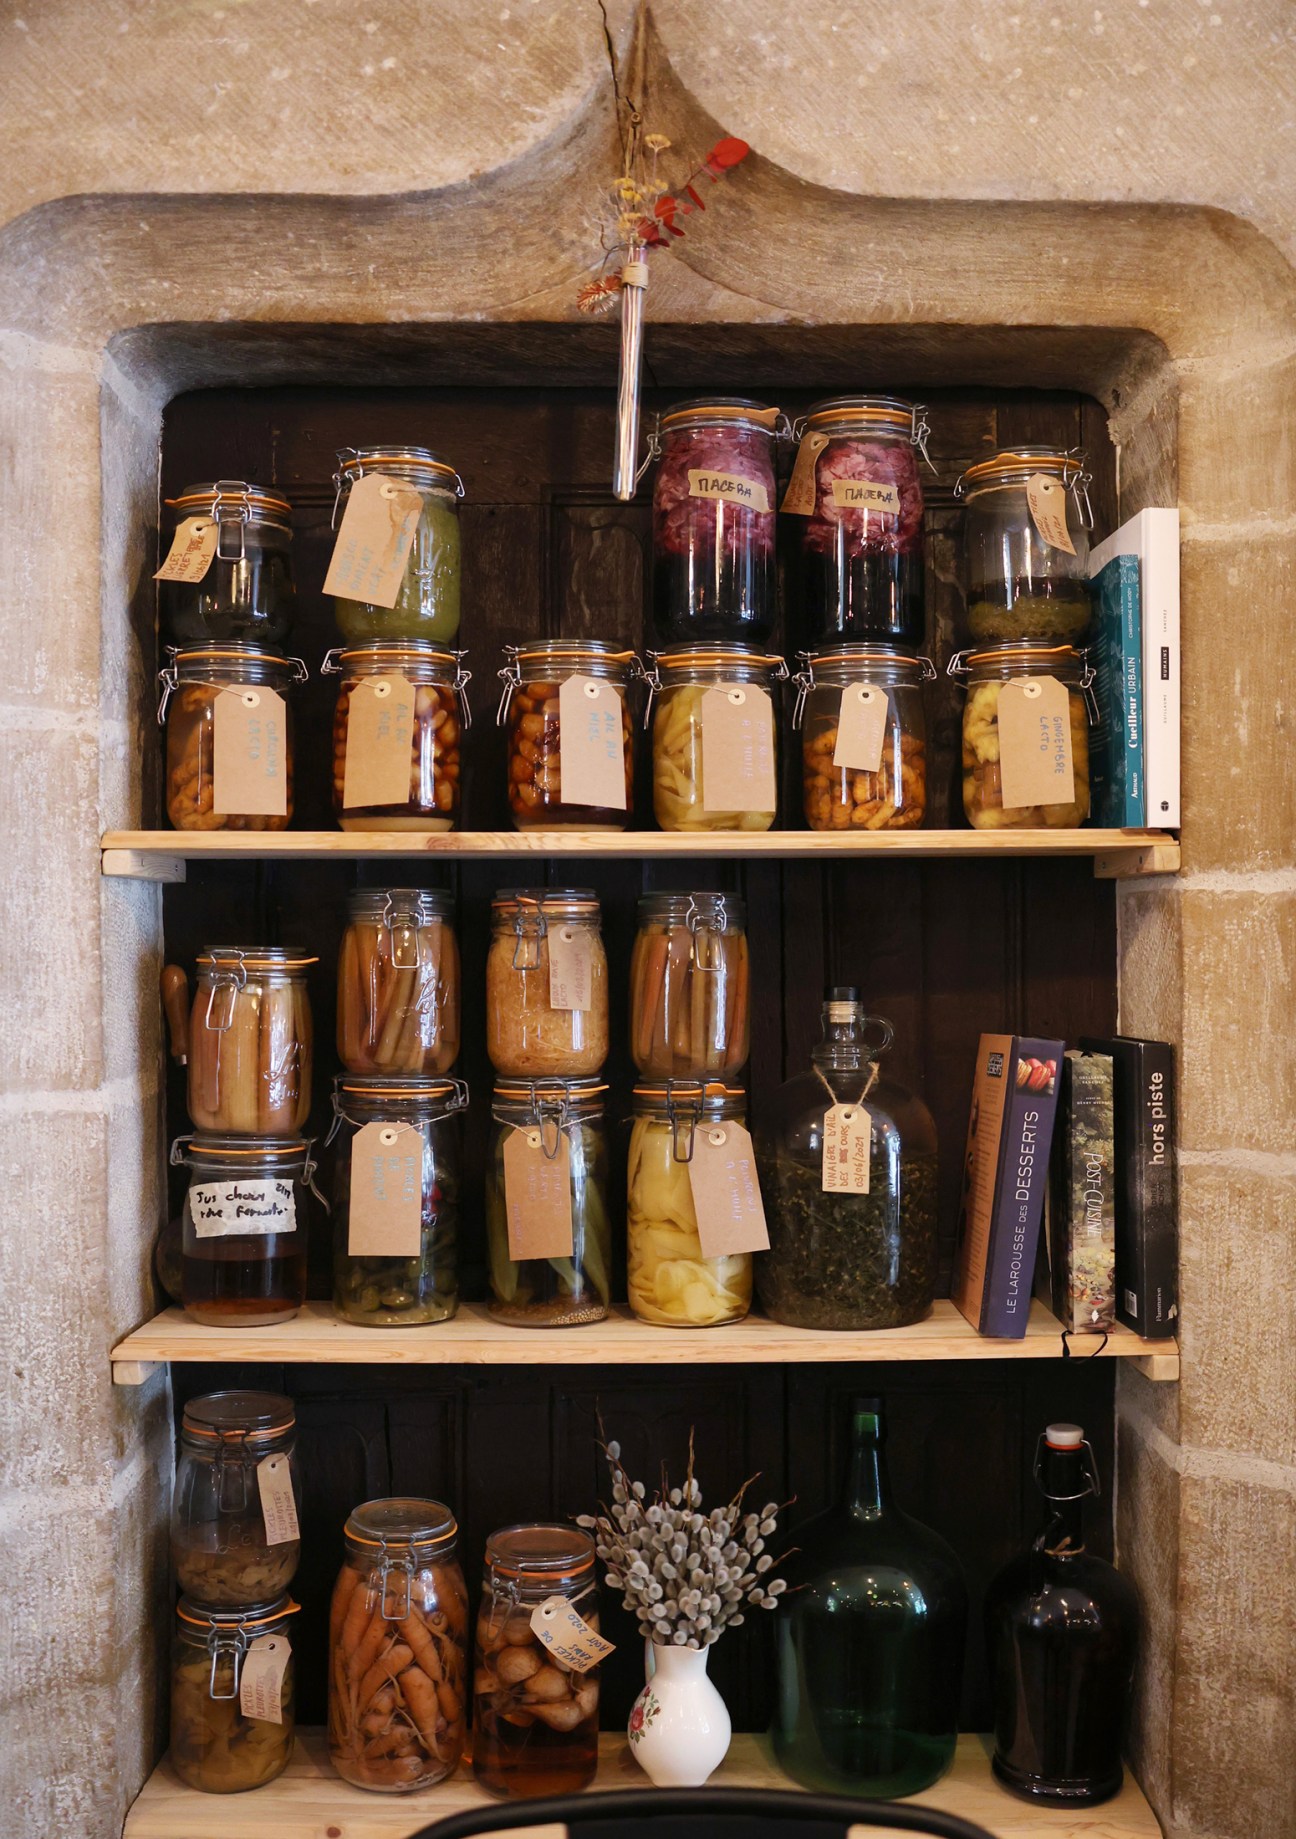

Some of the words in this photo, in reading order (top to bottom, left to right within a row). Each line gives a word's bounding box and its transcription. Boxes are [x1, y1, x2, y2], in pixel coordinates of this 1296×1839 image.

[1127, 656, 1138, 694] URBAIN
[1040, 715, 1050, 752] LACTO
[1127, 696, 1138, 749] Cueilleur
[1053, 716, 1066, 775] GINGEMBRE
[1147, 1072, 1167, 1119] piste
[840, 1125, 850, 1146] OURS
[1148, 1123, 1165, 1165] hors
[852, 1136, 867, 1188] 03/06/2021
[1015, 1111, 1039, 1201] DESSERTS
[196, 1191, 217, 1204] Jus
[840, 1171, 849, 1187] DES
[1083, 1152, 1105, 1237] POST-CUISINE
[1018, 1205, 1029, 1222] DES
[1008, 1226, 1026, 1295] LAROUSSE
[1006, 1299, 1017, 1314] LE
[541, 1630, 554, 1643] DE
[567, 1613, 589, 1635] 2020
[553, 1645, 588, 1669] PICKLES
